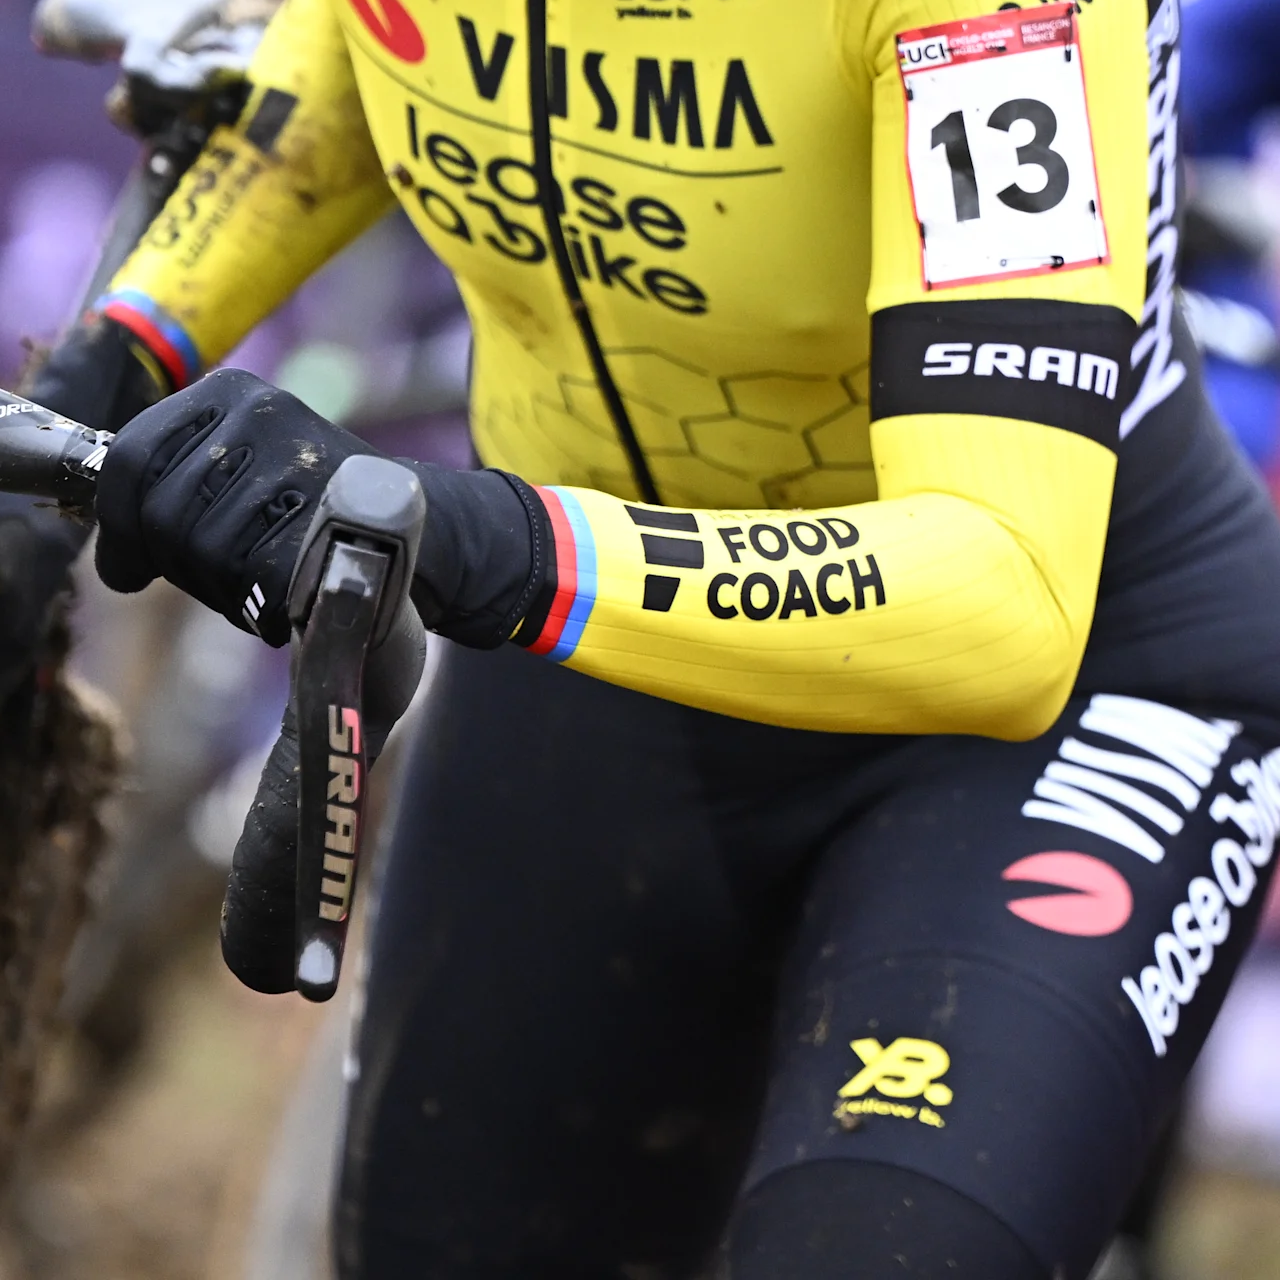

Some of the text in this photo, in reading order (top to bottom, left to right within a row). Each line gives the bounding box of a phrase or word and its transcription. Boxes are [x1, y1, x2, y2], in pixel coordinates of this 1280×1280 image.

[907, 42, 947, 64] UCI
[949, 27, 1015, 48] CYCLO-CROSS
[951, 40, 985, 56] WORLD
[1021, 19, 1070, 35] BESANÇON
[1022, 31, 1056, 45] FRANCE
[457, 16, 775, 149] VISMA
[406, 103, 687, 251] lease
[930, 97, 1070, 223] 13
[922, 342, 1120, 400] SRAM
[717, 516, 861, 564] FOOD
[706, 553, 887, 621] COACH
[1020, 692, 1243, 865] VISMA
[319, 703, 364, 923] SRAM
[1121, 874, 1231, 1058] lease
